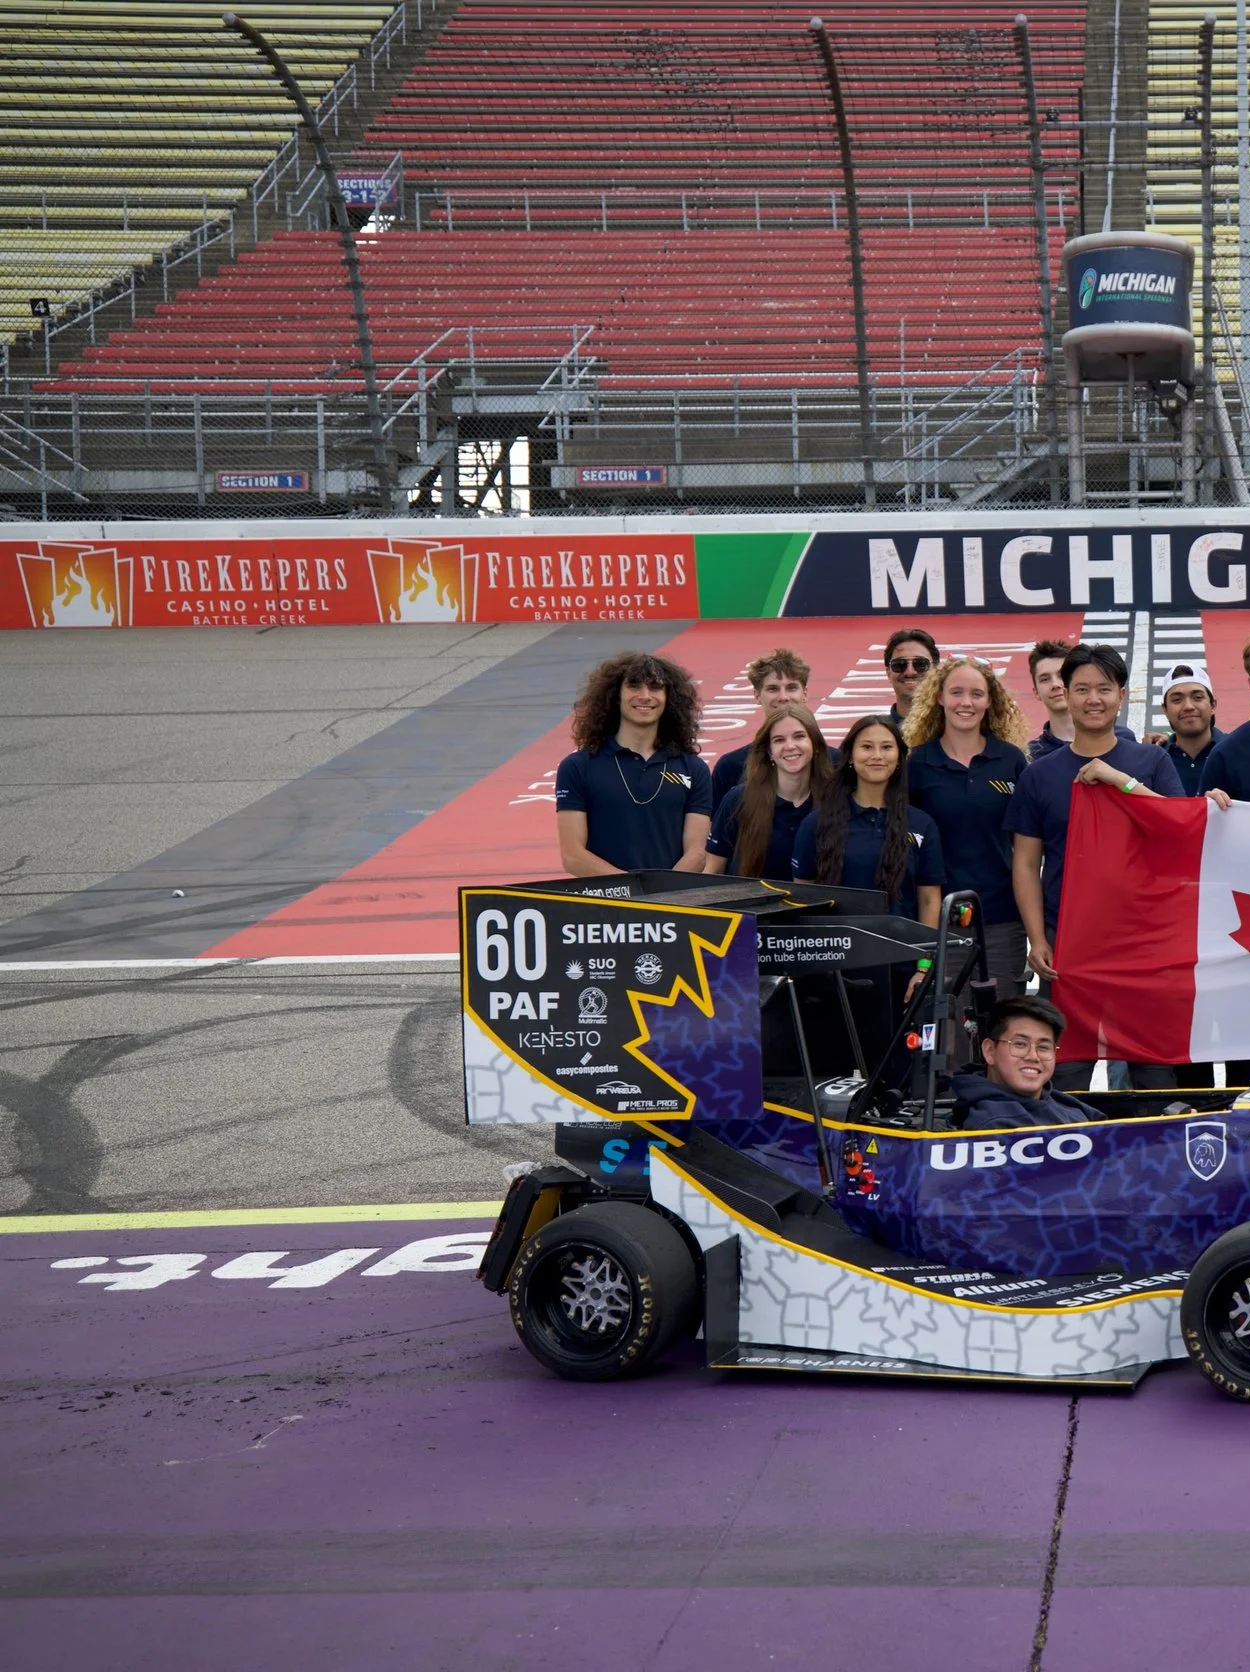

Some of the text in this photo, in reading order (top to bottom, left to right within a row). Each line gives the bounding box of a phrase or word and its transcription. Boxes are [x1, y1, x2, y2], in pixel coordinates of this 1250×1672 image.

[1098, 272, 1176, 295] MICHIGAN
[34, 301, 47, 313] 4
[222, 476, 292, 487] SECTION 1
[582, 470, 651, 481] SECTION 1
[166, 599, 330, 613] CASINO HOTEL
[509, 595, 668, 608] CASINO HOTEL
[192, 614, 307, 625] BATTLE CREEK
[534, 610, 645, 621] BATTLE CREEK
[561, 922, 678, 945] SIEMENS
[475, 908, 548, 982] 60
[767, 936, 852, 952] Engineering
[774, 952, 795, 962] tube
[797, 950, 846, 962] fabrication
[588, 958, 617, 969] SUO
[489, 991, 560, 1021] PAF
[519, 1027, 601, 1052] KENESTO
[556, 1064, 619, 1077] easycomposites
[930, 1133, 1094, 1171] UBCO
[867, 1193, 881, 1201] LV
[953, 1278, 1048, 1298] Altium
[1056, 1270, 1191, 1308] SIEMENS
